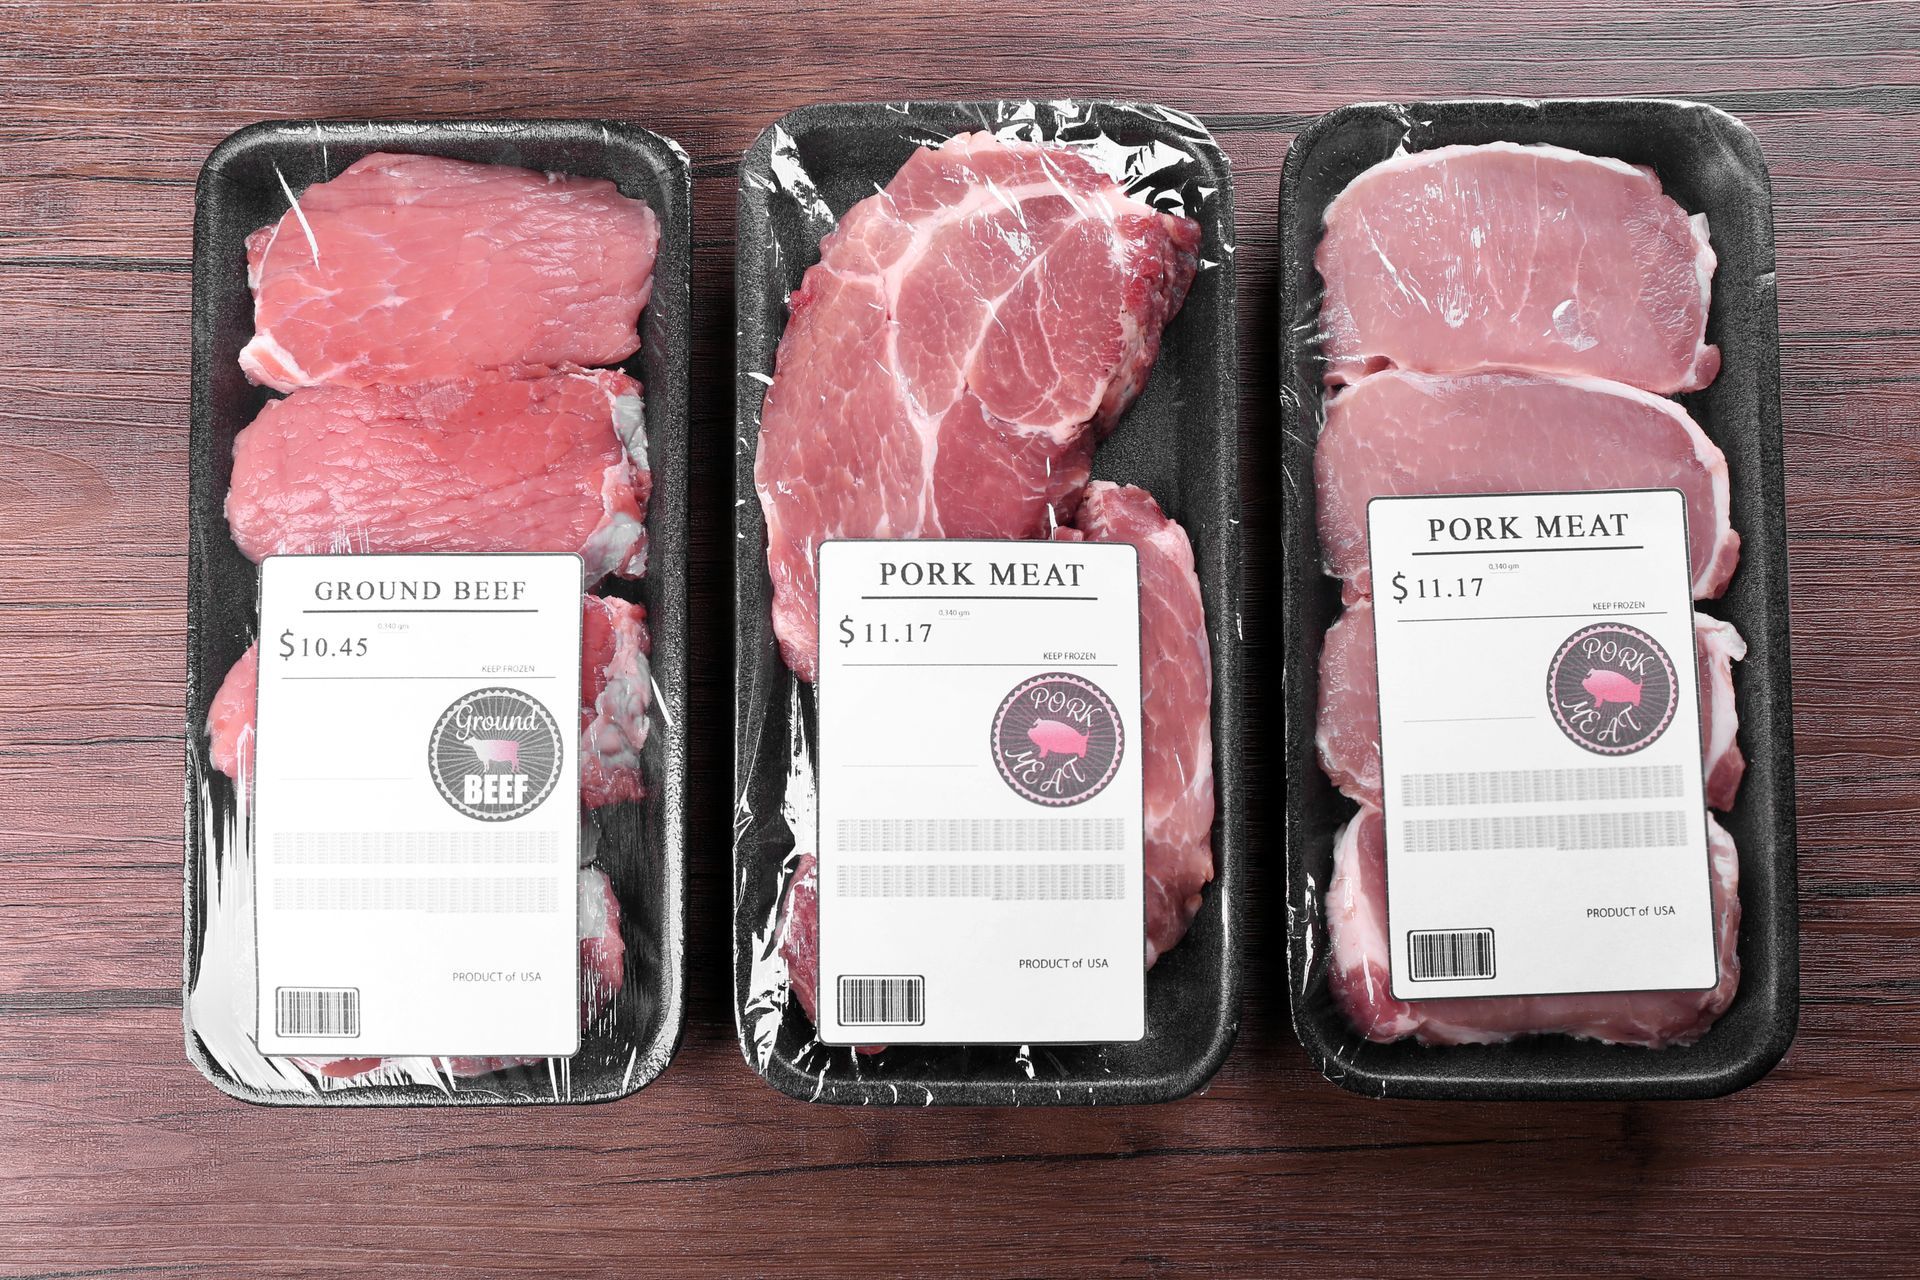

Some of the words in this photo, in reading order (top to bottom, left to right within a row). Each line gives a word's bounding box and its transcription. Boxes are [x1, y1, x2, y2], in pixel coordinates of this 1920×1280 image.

[1428, 516, 1523, 542] PORK
[1534, 513, 1629, 539] MEAT
[879, 561, 975, 586] PORK
[988, 562, 1085, 587] MEAT
[314, 580, 441, 601] GROUND
[453, 580, 526, 601] BEEF
[1592, 601, 1611, 610] KEEP
[1613, 600, 1646, 609] FROZEN
[481, 663, 501, 673] KEEP
[503, 663, 536, 673] FROZEN
[1043, 651, 1063, 661] KEEP
[1064, 651, 1097, 661] FROZEN
[1583, 637, 1655, 676] PORK
[1030, 687, 1103, 728] PORK
[455, 703, 541, 741] Ground
[1561, 700, 1641, 743] MEAT
[1004, 749, 1086, 794] MEAT
[463, 774, 529, 805] BEEF
[1586, 906, 1637, 919] PRODUCT
[1638, 905, 1650, 917] of
[1653, 905, 1676, 917] USA
[1019, 958, 1071, 969] PRODUCT
[1071, 957, 1084, 969] of
[1087, 958, 1109, 969] USA
[452, 972, 504, 983] PRODUCT
[504, 971, 517, 983] of
[520, 972, 542, 982] USA
